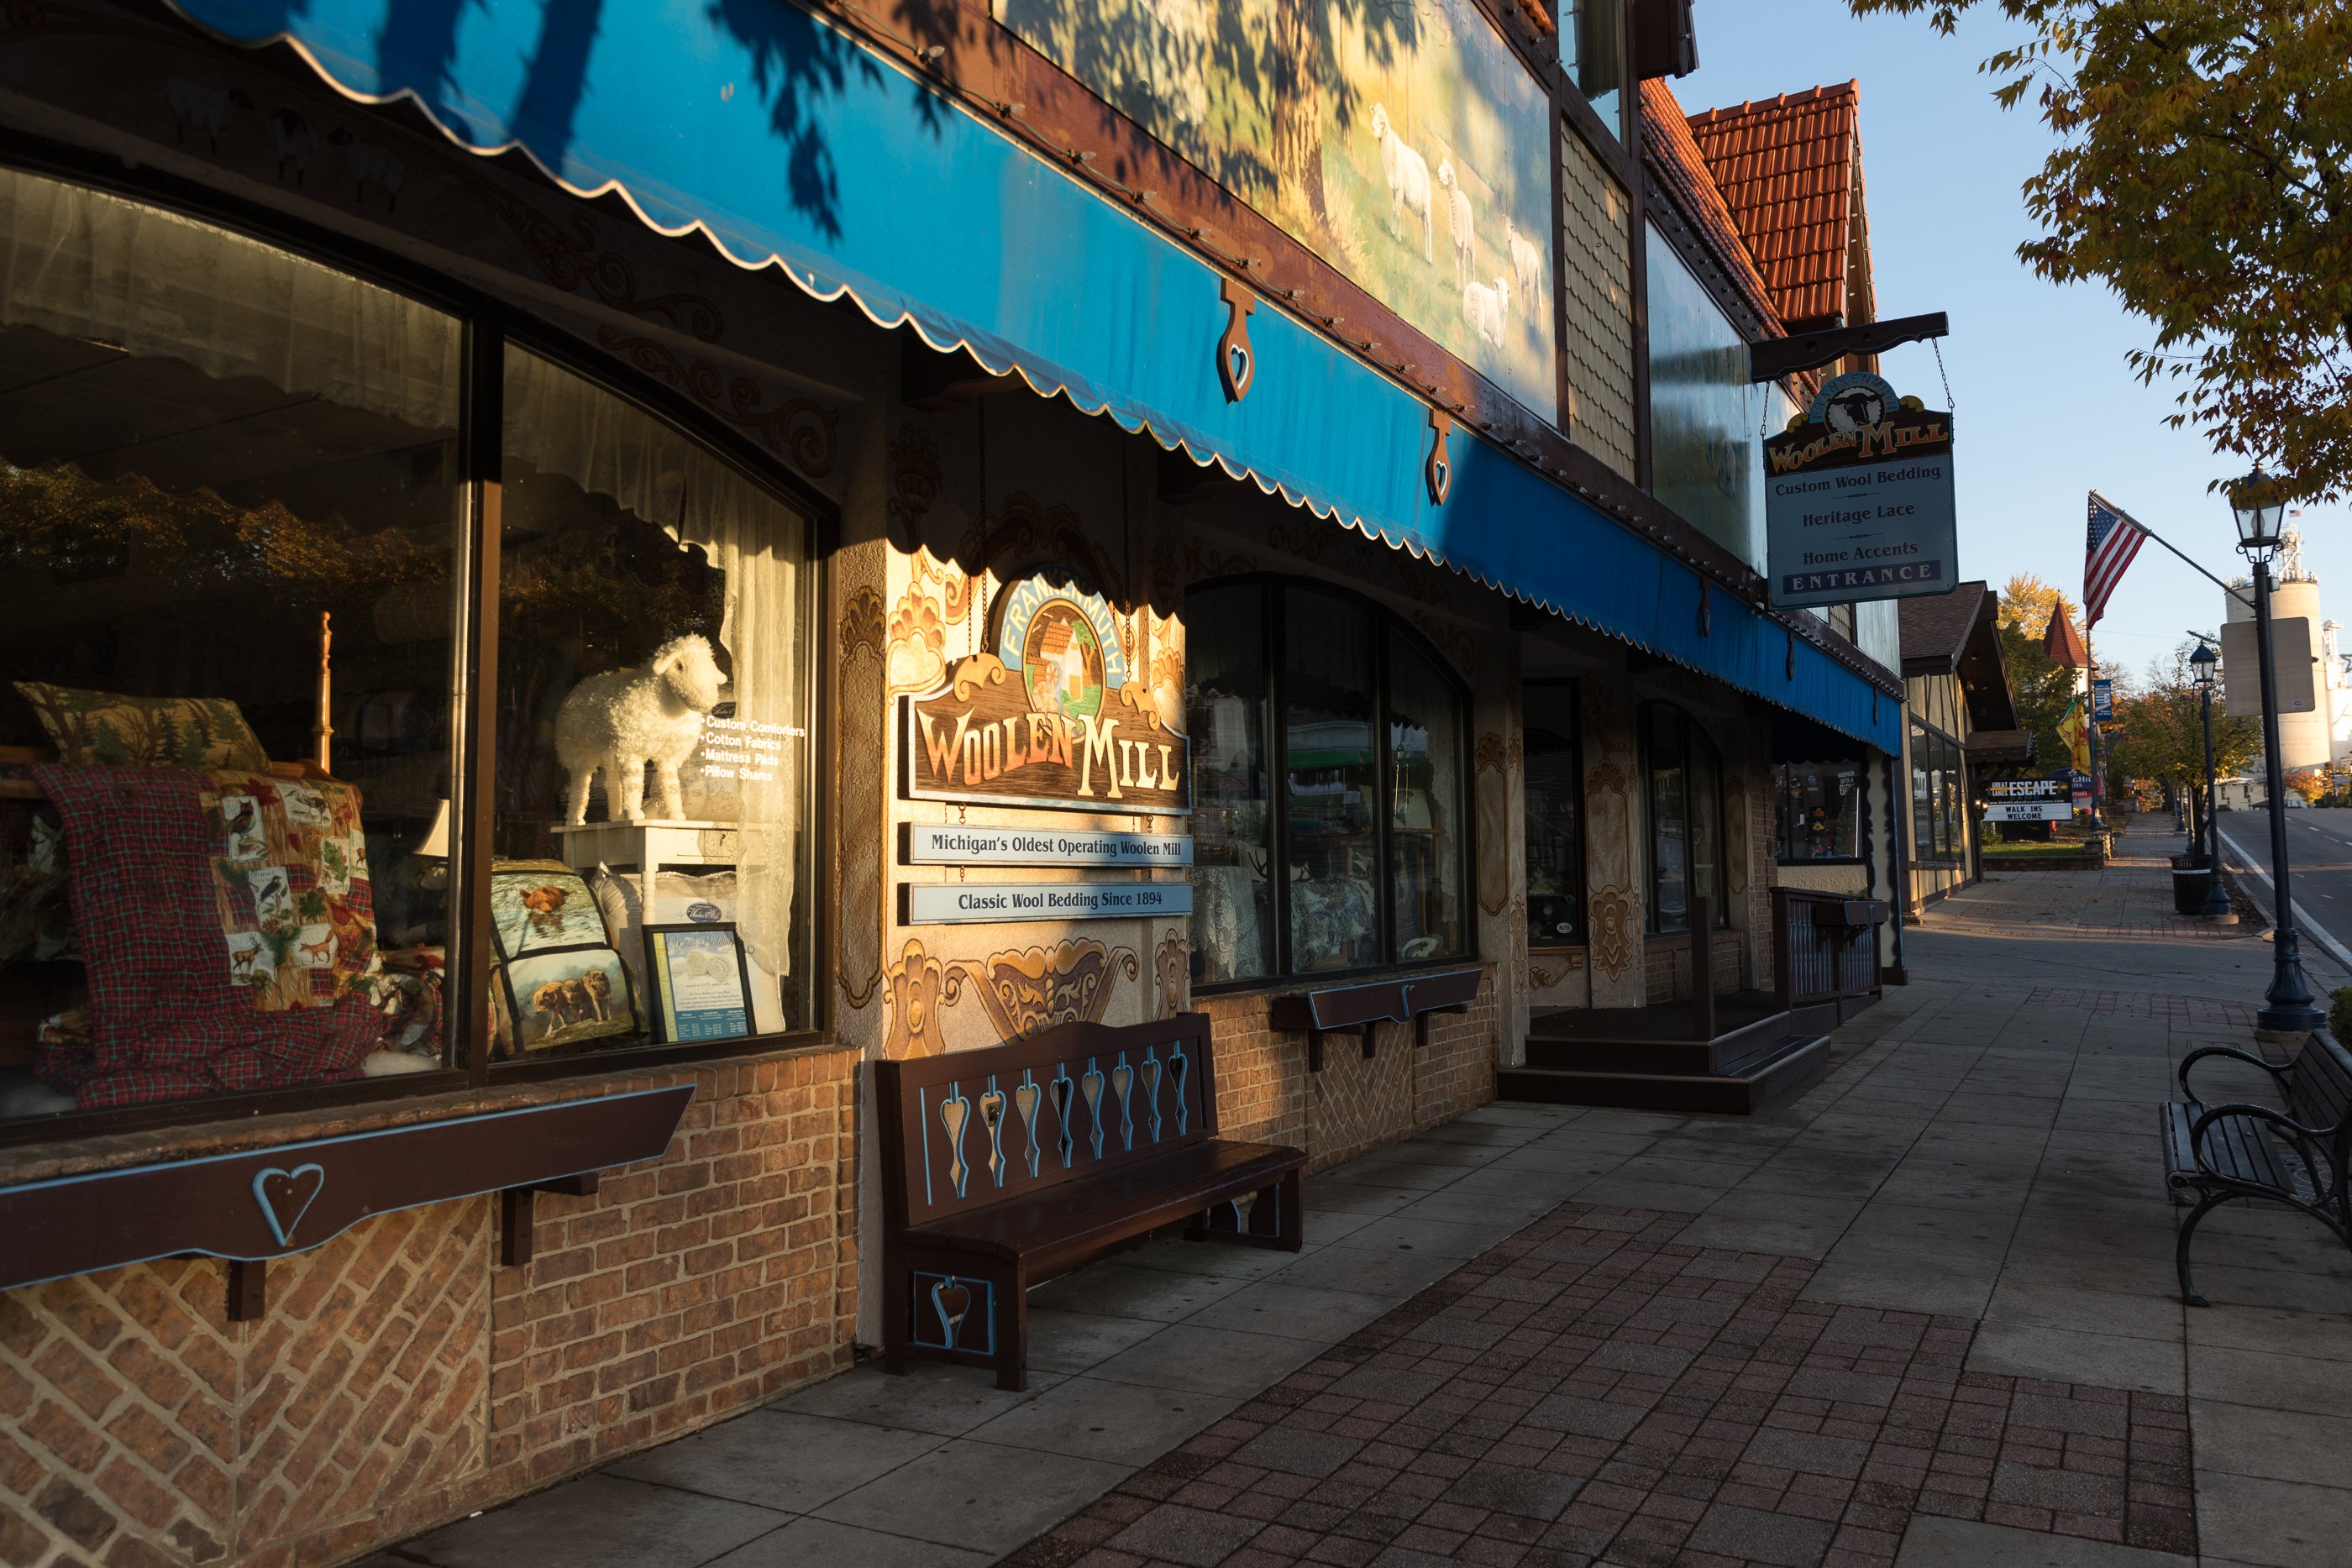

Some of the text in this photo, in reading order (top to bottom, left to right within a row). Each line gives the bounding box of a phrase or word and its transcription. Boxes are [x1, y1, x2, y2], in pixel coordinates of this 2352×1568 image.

[1812, 373, 1898, 419] FRANKENMUTH
[1768, 421, 1949, 474] WOOLEN MILL
[1775, 465, 1941, 496] Custom Wool Bedding
[1802, 504, 1915, 527] Heritage Lace
[1803, 542, 1919, 565] Home Accents
[1792, 564, 1932, 591] ENTRANCE
[1004, 568, 1122, 674] FRANKENMUTH
[706, 716, 806, 737] Custom Comforters
[706, 732, 782, 751] Cotton Fabrics
[916, 705, 1180, 798] WOOLEN MILL
[705, 748, 779, 766] Mattress Pads
[705, 765, 773, 782] Pillow Shams
[2009, 780, 2057, 796] ESCAPE
[932, 834, 1181, 857] Michigan's Oldest Operating Woolen Mill
[958, 890, 1163, 910] Classic Wool Bedding Since 1894
